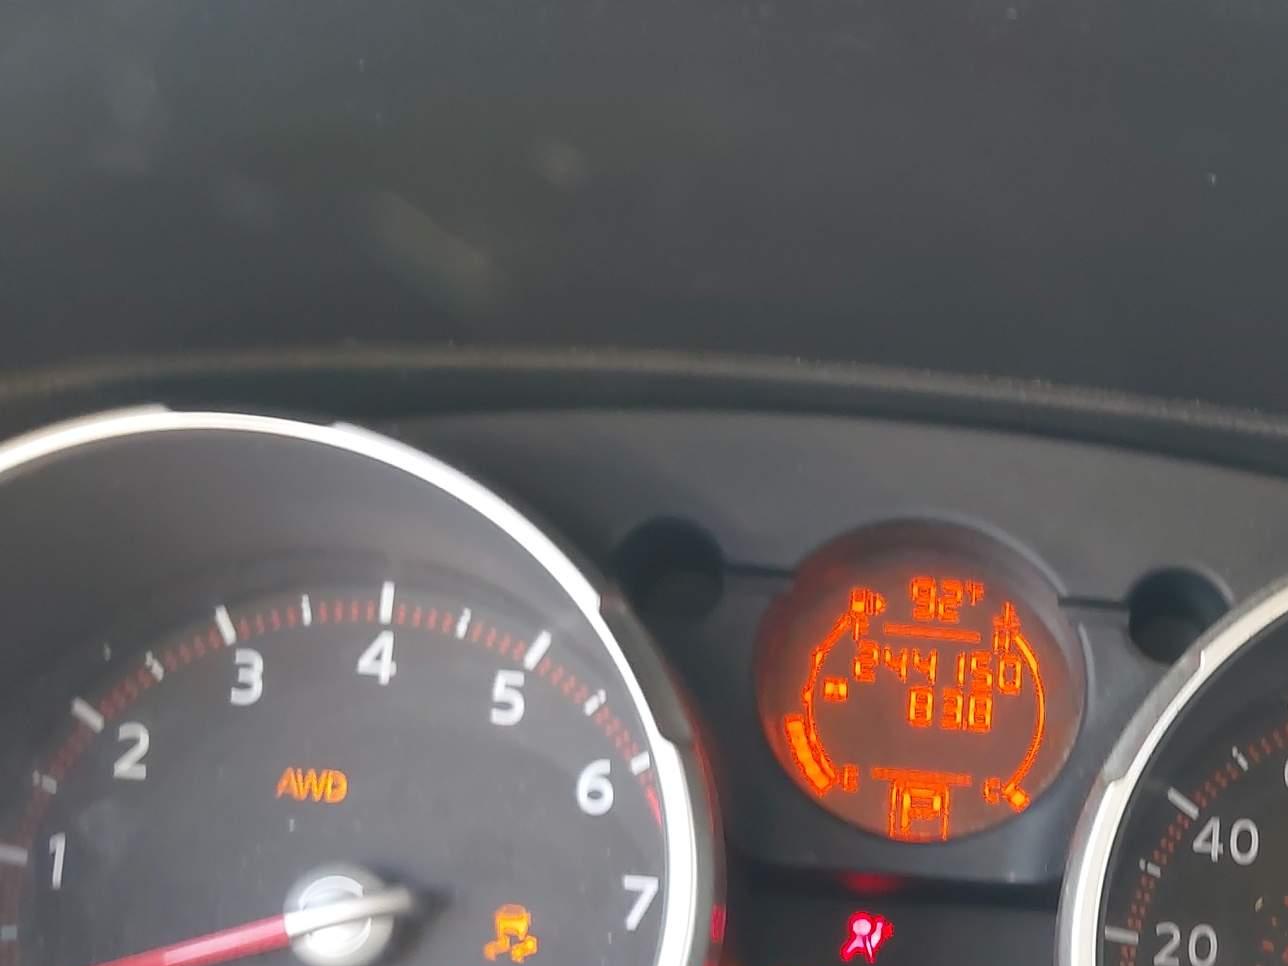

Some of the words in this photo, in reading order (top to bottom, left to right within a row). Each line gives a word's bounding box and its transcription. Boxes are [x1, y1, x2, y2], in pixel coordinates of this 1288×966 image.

[230, 649, 264, 705] 3
[358, 631, 397, 686] 4
[490, 670, 526, 727] 5
[113, 722, 151, 781] 2
[275, 767, 348, 804] AWD
[576, 758, 614, 816] 6
[48, 831, 67, 891] 1
[1192, 817, 1260, 866] 40
[622, 875, 659, 931] 7
